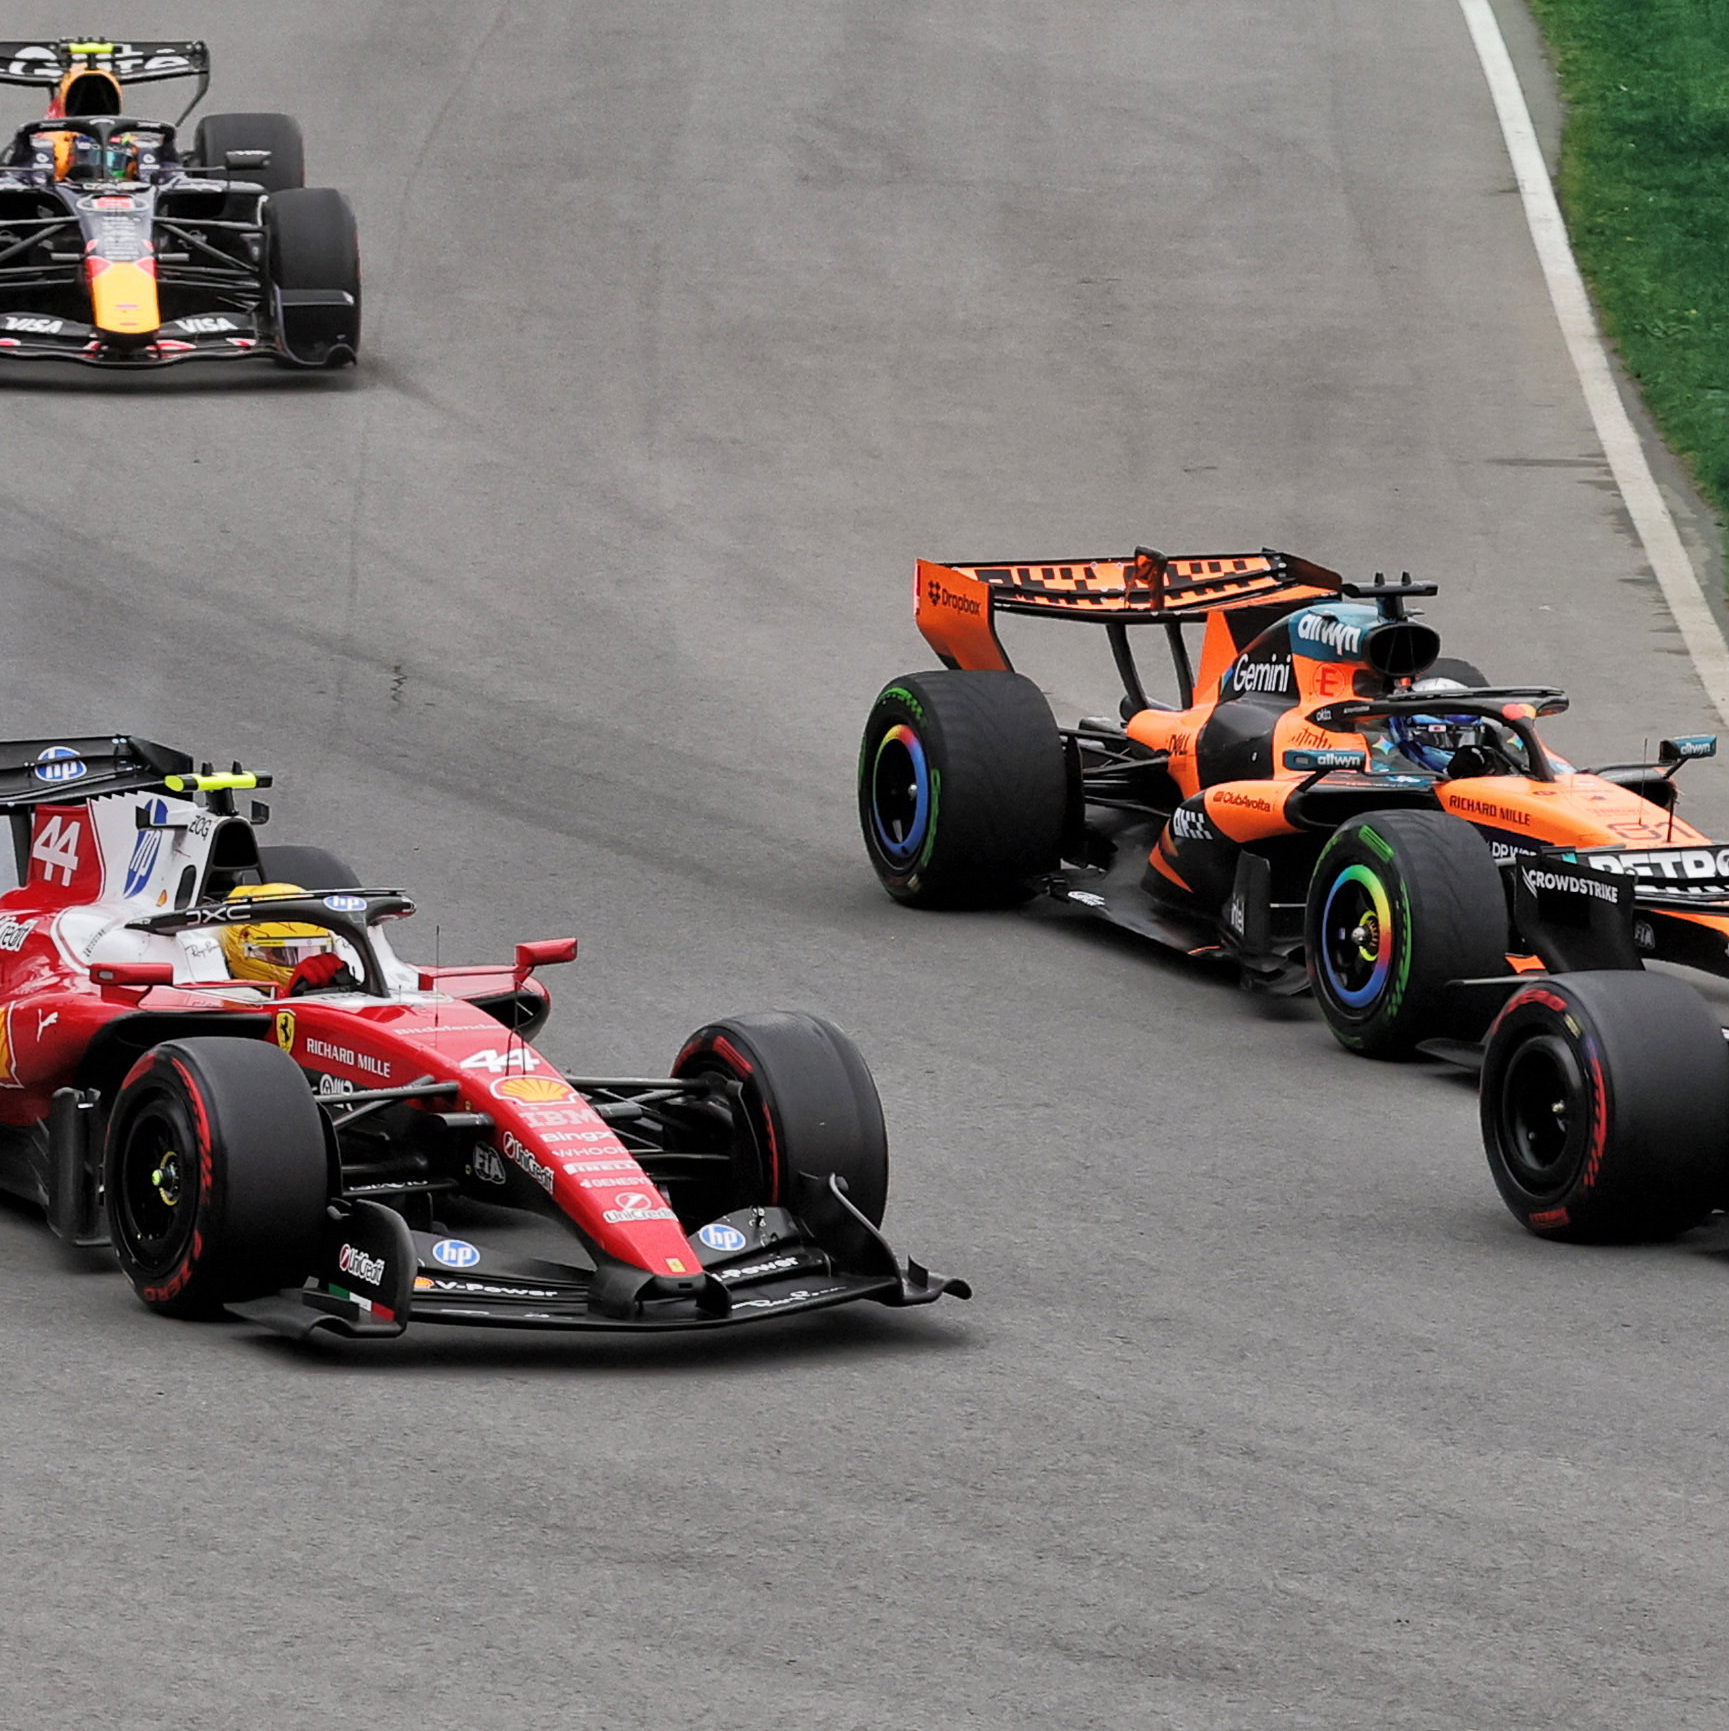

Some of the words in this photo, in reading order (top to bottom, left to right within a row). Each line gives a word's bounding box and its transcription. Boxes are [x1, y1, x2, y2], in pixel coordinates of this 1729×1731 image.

[6, 316, 63, 334] VISA
[175, 316, 239, 334] VISA
[942, 589, 981, 617] Dropbox
[1297, 613, 1362, 657] allwyn
[1233, 653, 1292, 693] Gemini
[1317, 752, 1361, 768] allwyn
[1680, 741, 1711, 757] allwyn
[1223, 791, 1272, 813] ClubAvolta
[1449, 795, 1498, 818] RICHARD
[1499, 808, 1531, 827] MILLE
[32, 815, 81, 888] 44
[1492, 841, 1508, 860] DP
[1528, 868, 1619, 903] CROWDSTRIKE
[332, 895, 361, 911] hp
[307, 1037, 355, 1067] RICHARD
[357, 1052, 392, 1079] MILLE
[459, 1049, 541, 1073] 44
[518, 1109, 602, 1129] IBM
[539, 1130, 615, 1143] BingX
[475, 1148, 502, 1182] FIA
[514, 1139, 555, 1196] UniCredit
[602, 1208, 678, 1225] UniCredit
[709, 1225, 739, 1251] hp
[348, 1247, 385, 1287] UniCredit
[442, 1241, 474, 1268] hp
[435, 1280, 559, 1298] V-Power
